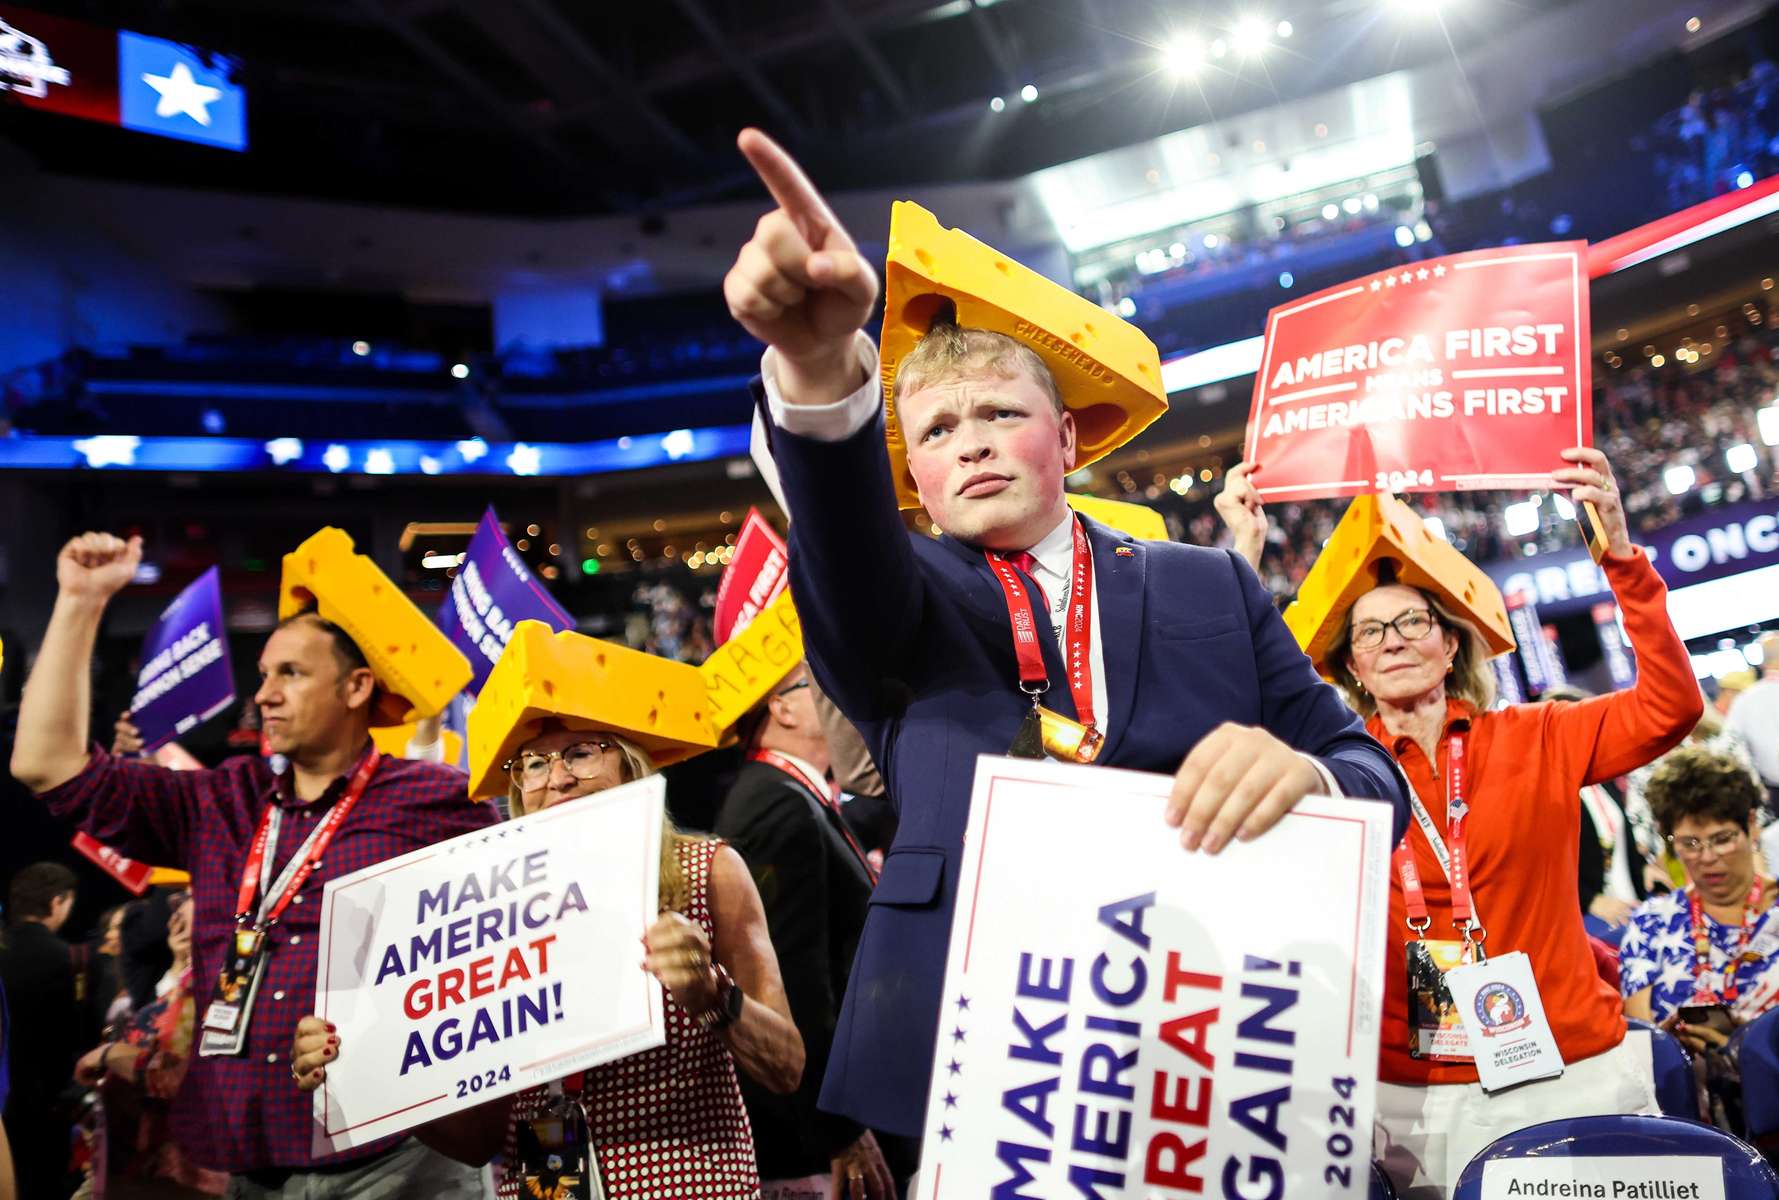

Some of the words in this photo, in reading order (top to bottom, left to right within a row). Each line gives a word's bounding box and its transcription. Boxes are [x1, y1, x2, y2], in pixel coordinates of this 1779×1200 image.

[1270, 334, 1436, 389] AMERICA
[1445, 324, 1564, 360] FIRST
[1262, 391, 1454, 438] AMERINS
[1464, 387, 1568, 417] FIRST
[1374, 469, 1434, 490] 2024
[1503, 545, 1658, 605] GRE
[1671, 510, 1779, 572] ONC
[485, 605, 515, 646] BA
[1014, 612, 1023, 631] DATA
[1020, 608, 1031, 630] TRUST
[704, 603, 800, 713] MAGA
[416, 849, 549, 925] MAKE
[374, 881, 589, 986] AMERICA
[403, 934, 557, 1020] GREAT
[399, 982, 565, 1076] AGAIN!
[1067, 890, 1157, 1200] MERICA
[1493, 1041, 1537, 1058] WISCONSIN
[1494, 1049, 1542, 1068] DELEGATION
[456, 1064, 512, 1098] 2024
[990, 951, 1075, 1200] MAKE
[1143, 950, 1223, 1200] REAT
[1221, 953, 1302, 1200] GAIN!
[1323, 1076, 1357, 1188] 2024
[1507, 1178, 1606, 1198] Andreina
[1612, 1180, 1700, 1200] Patilliet
